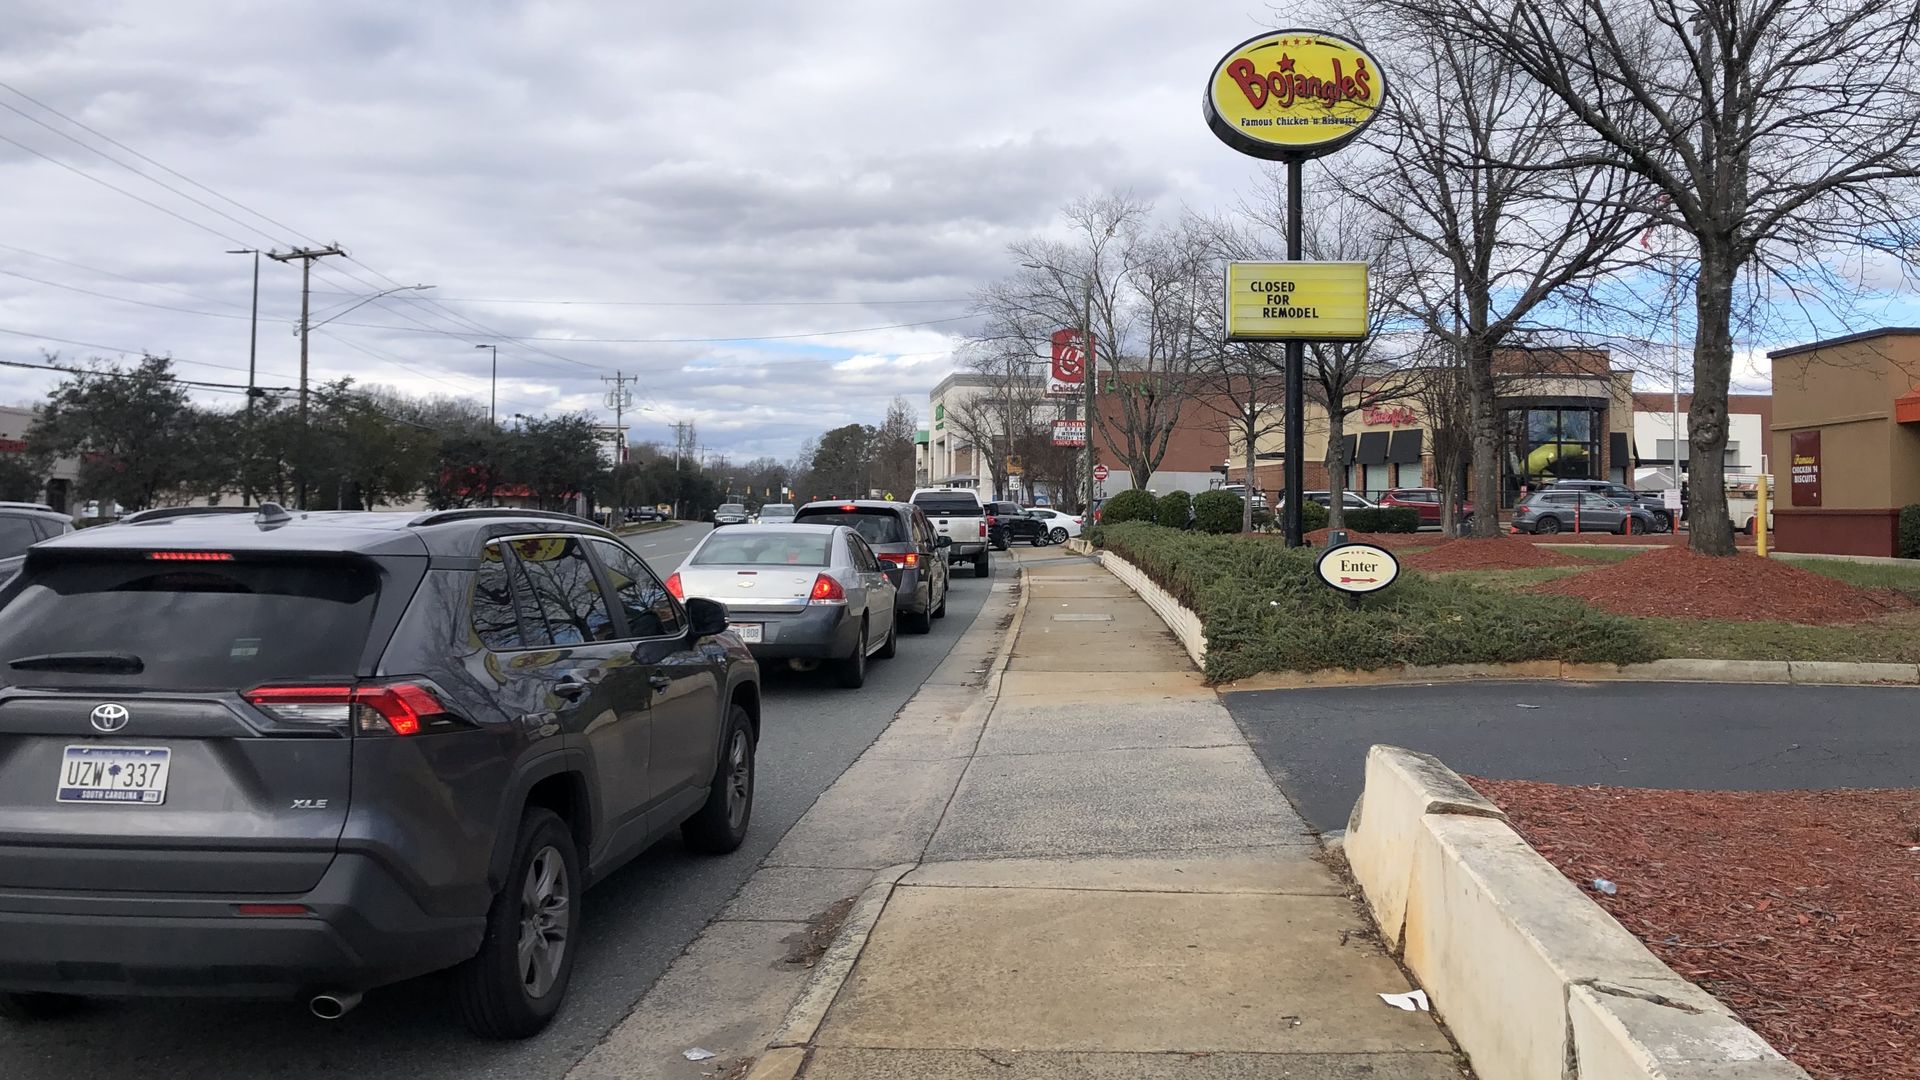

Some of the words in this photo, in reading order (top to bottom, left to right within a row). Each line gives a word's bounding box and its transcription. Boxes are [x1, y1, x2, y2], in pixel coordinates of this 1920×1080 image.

[1241, 117, 1273, 126] Famous
[1276, 116, 1309, 125] Chicken
[1250, 281, 1295, 292] CLOSED
[1267, 294, 1289, 305] FOR
[1263, 307, 1319, 318] REMODEL
[1792, 465, 1812, 474] CHICKEN
[1794, 474, 1817, 483] BISCUITS
[1340, 560, 1378, 572] Enter
[67, 761, 105, 787] UZW
[123, 763, 161, 788] 337
[81, 790, 103, 799] SOUTH
[104, 790, 137, 800] CAROLINA
[290, 799, 328, 808] XLE
